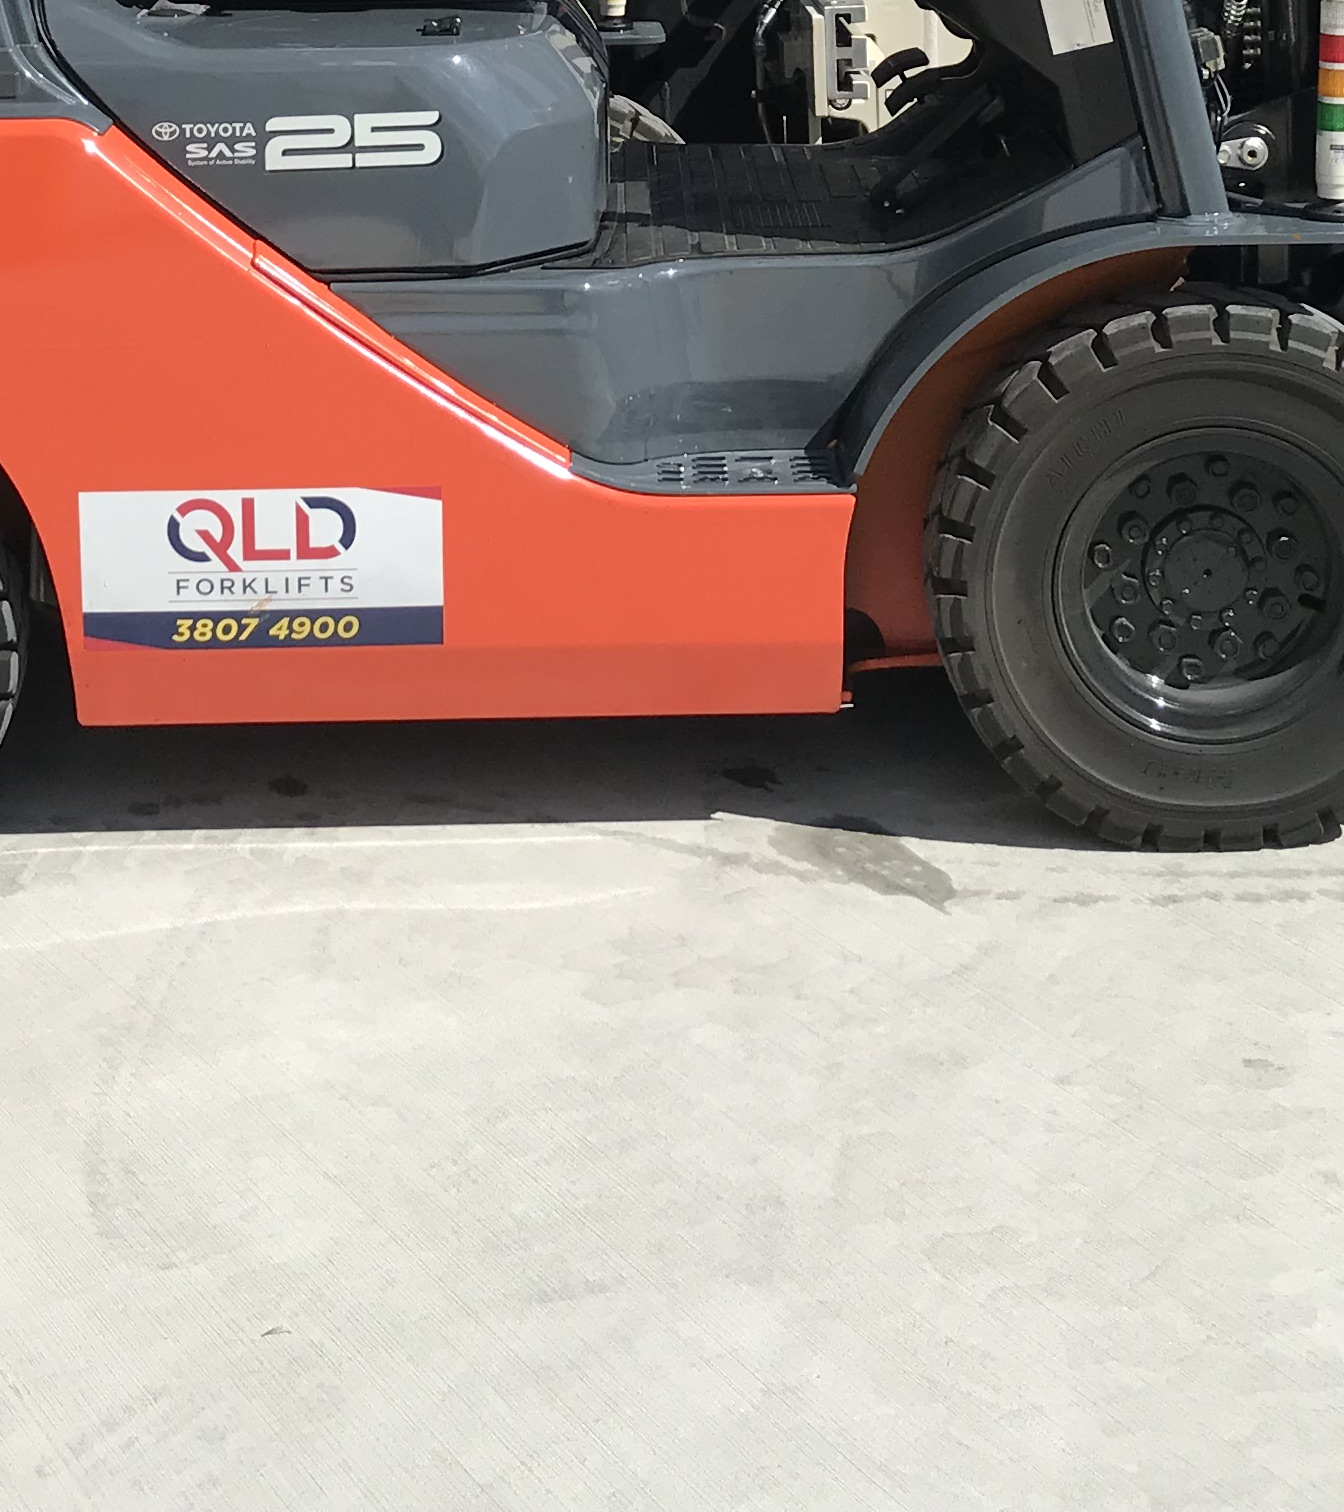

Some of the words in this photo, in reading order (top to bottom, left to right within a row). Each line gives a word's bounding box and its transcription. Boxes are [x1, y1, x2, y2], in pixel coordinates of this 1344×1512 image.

[182, 122, 256, 138] TOYOTA
[265, 110, 442, 171] 25
[185, 141, 257, 159] SAS
[187, 159, 208, 167] System
[234, 158, 256, 166] Stability
[167, 496, 357, 572] QLD
[175, 575, 354, 596] FORKLIFTS
[171, 617, 261, 642] 3807
[268, 615, 360, 641] 4900
